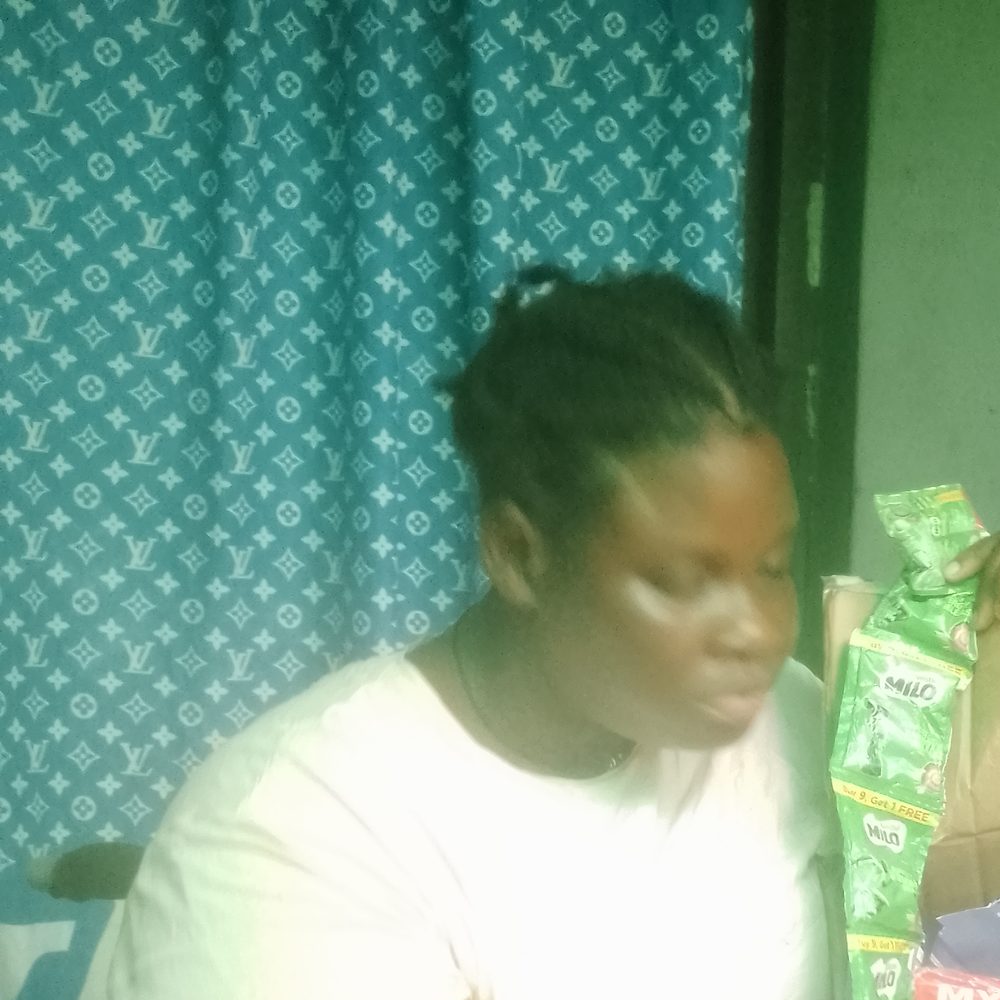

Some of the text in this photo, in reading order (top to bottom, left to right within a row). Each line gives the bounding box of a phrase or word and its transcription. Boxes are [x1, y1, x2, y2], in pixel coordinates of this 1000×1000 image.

[883, 675, 937, 702] MILO
[899, 805, 930, 823] FREE
[867, 823, 900, 847] MILO
